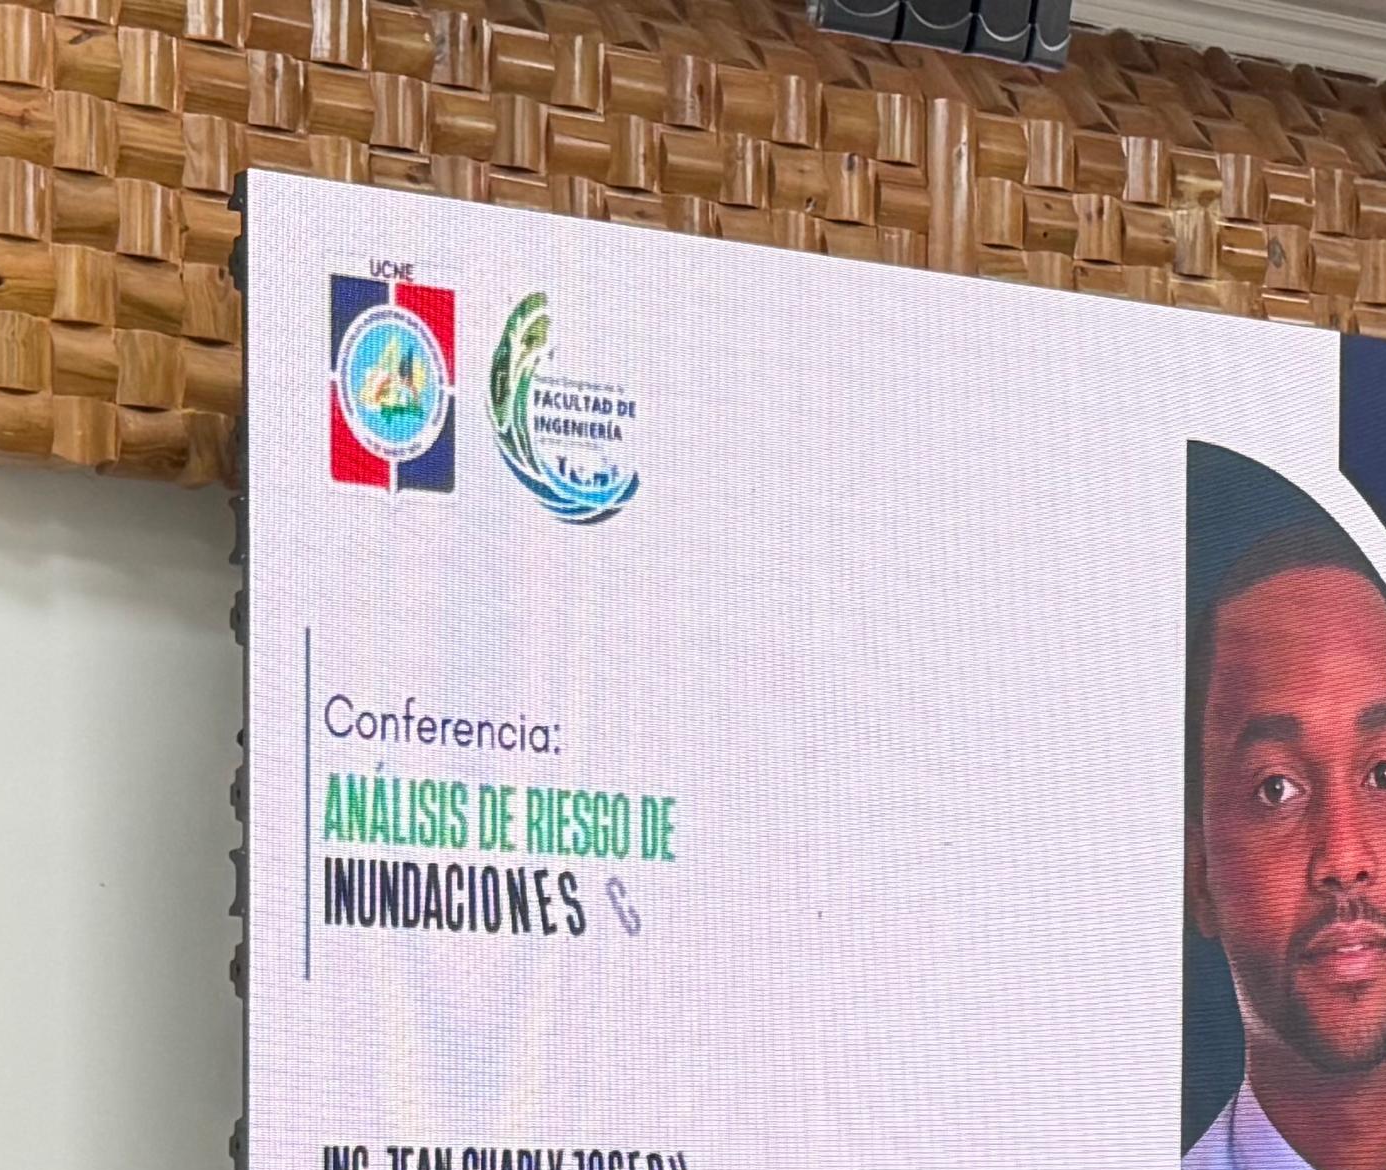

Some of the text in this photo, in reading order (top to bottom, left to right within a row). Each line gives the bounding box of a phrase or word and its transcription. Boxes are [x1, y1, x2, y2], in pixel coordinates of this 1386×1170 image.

[370, 259, 414, 281] UCNE
[533, 389, 637, 418] FACULTAD DE
[533, 415, 622, 440] INGENIERÍA
[324, 693, 562, 755] Conferencia:
[324, 762, 676, 862] ANÁLISIS DE RIESGO DE
[324, 857, 586, 936] INUNDACIONES
